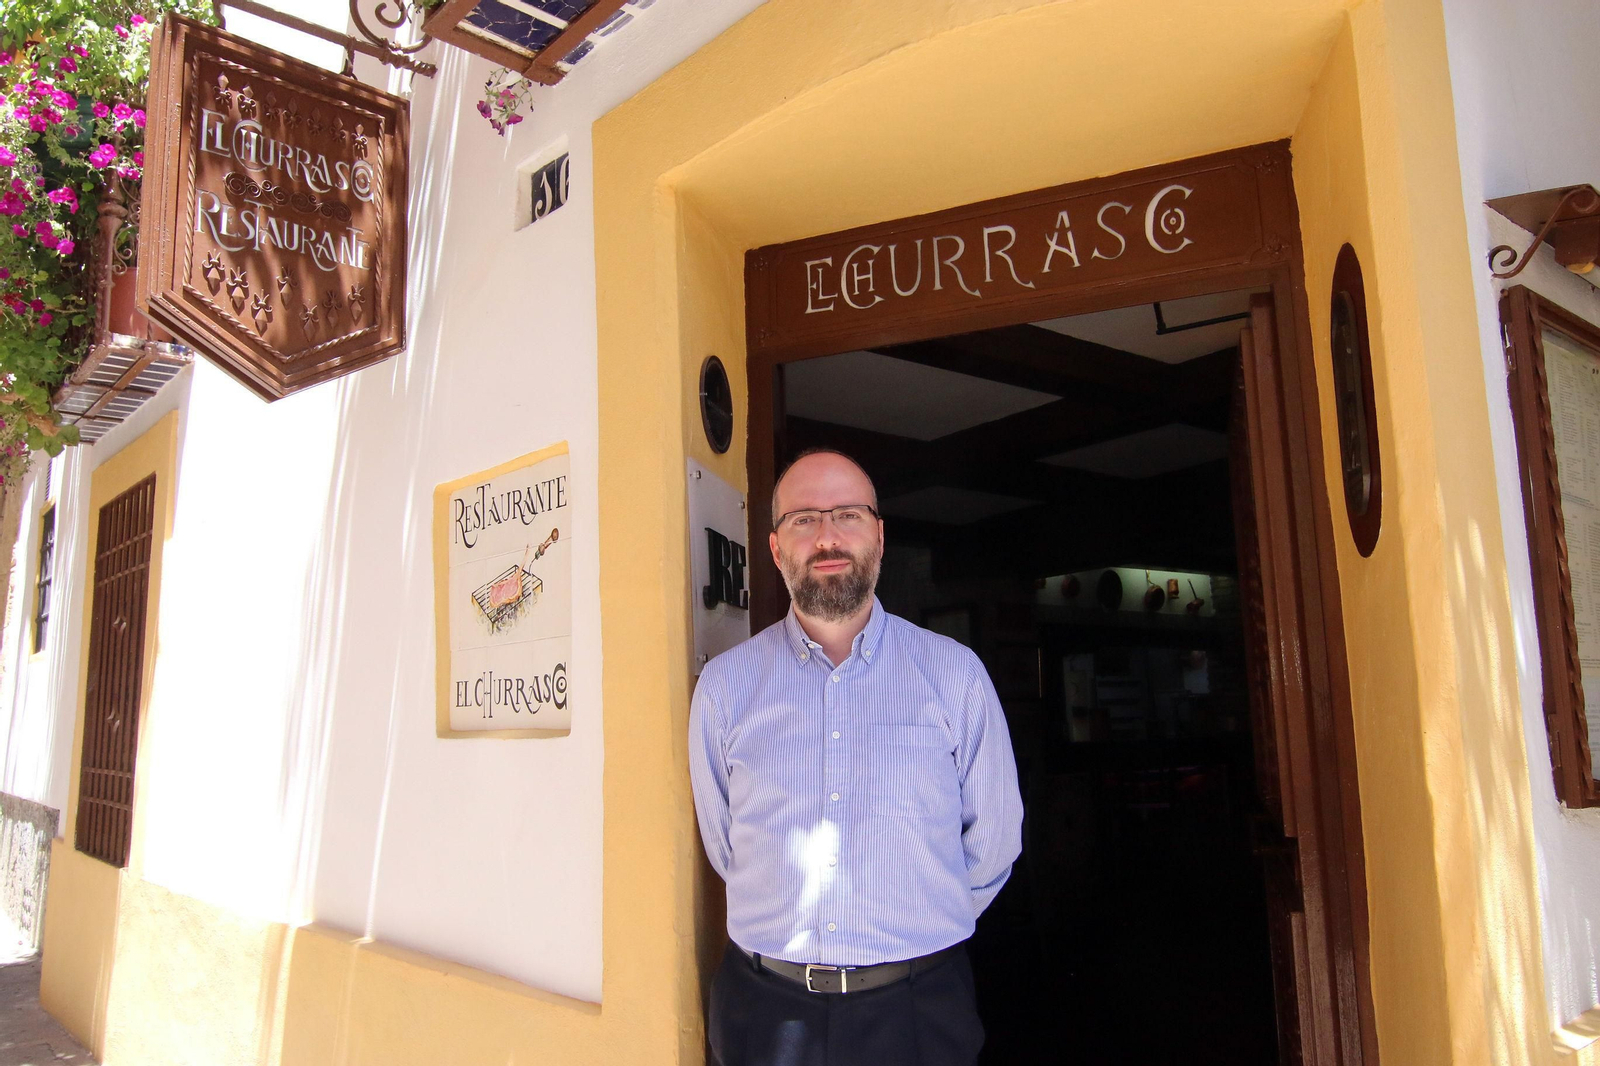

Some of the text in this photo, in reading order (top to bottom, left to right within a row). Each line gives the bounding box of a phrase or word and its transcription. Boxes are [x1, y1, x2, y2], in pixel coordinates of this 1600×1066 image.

[200, 108, 231, 158] EL
[195, 189, 372, 272] RESTAURANTE
[804, 257, 839, 314] EL
[454, 475, 568, 549] RESTAURANTE
[455, 680, 472, 708] EL
